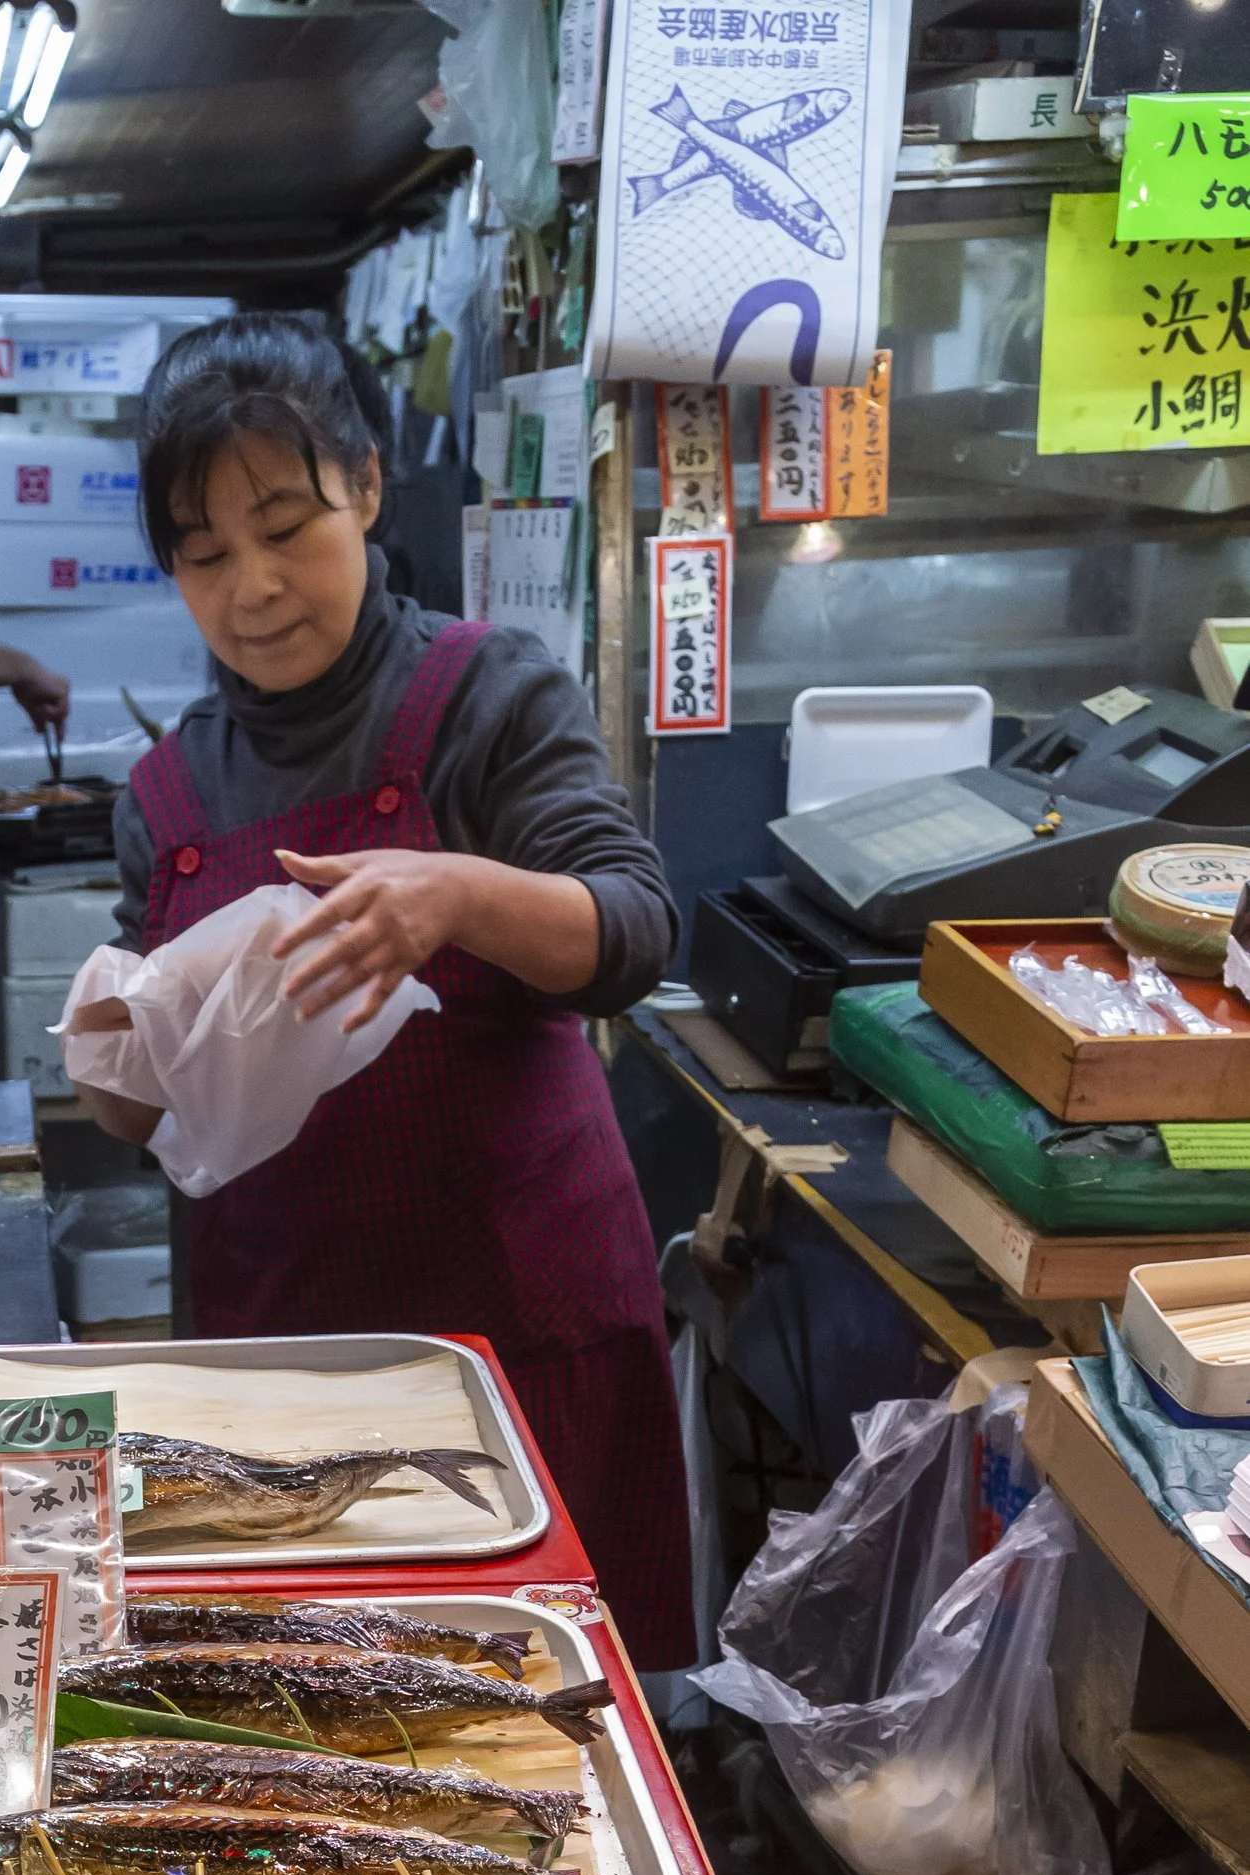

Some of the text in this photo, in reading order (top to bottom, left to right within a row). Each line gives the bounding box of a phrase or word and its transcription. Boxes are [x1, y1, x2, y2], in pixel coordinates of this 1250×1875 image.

[657, 7, 840, 44] 京都水産協会
[1030, 94, 1057, 127] 長
[1135, 370, 1241, 433] 小鯛
